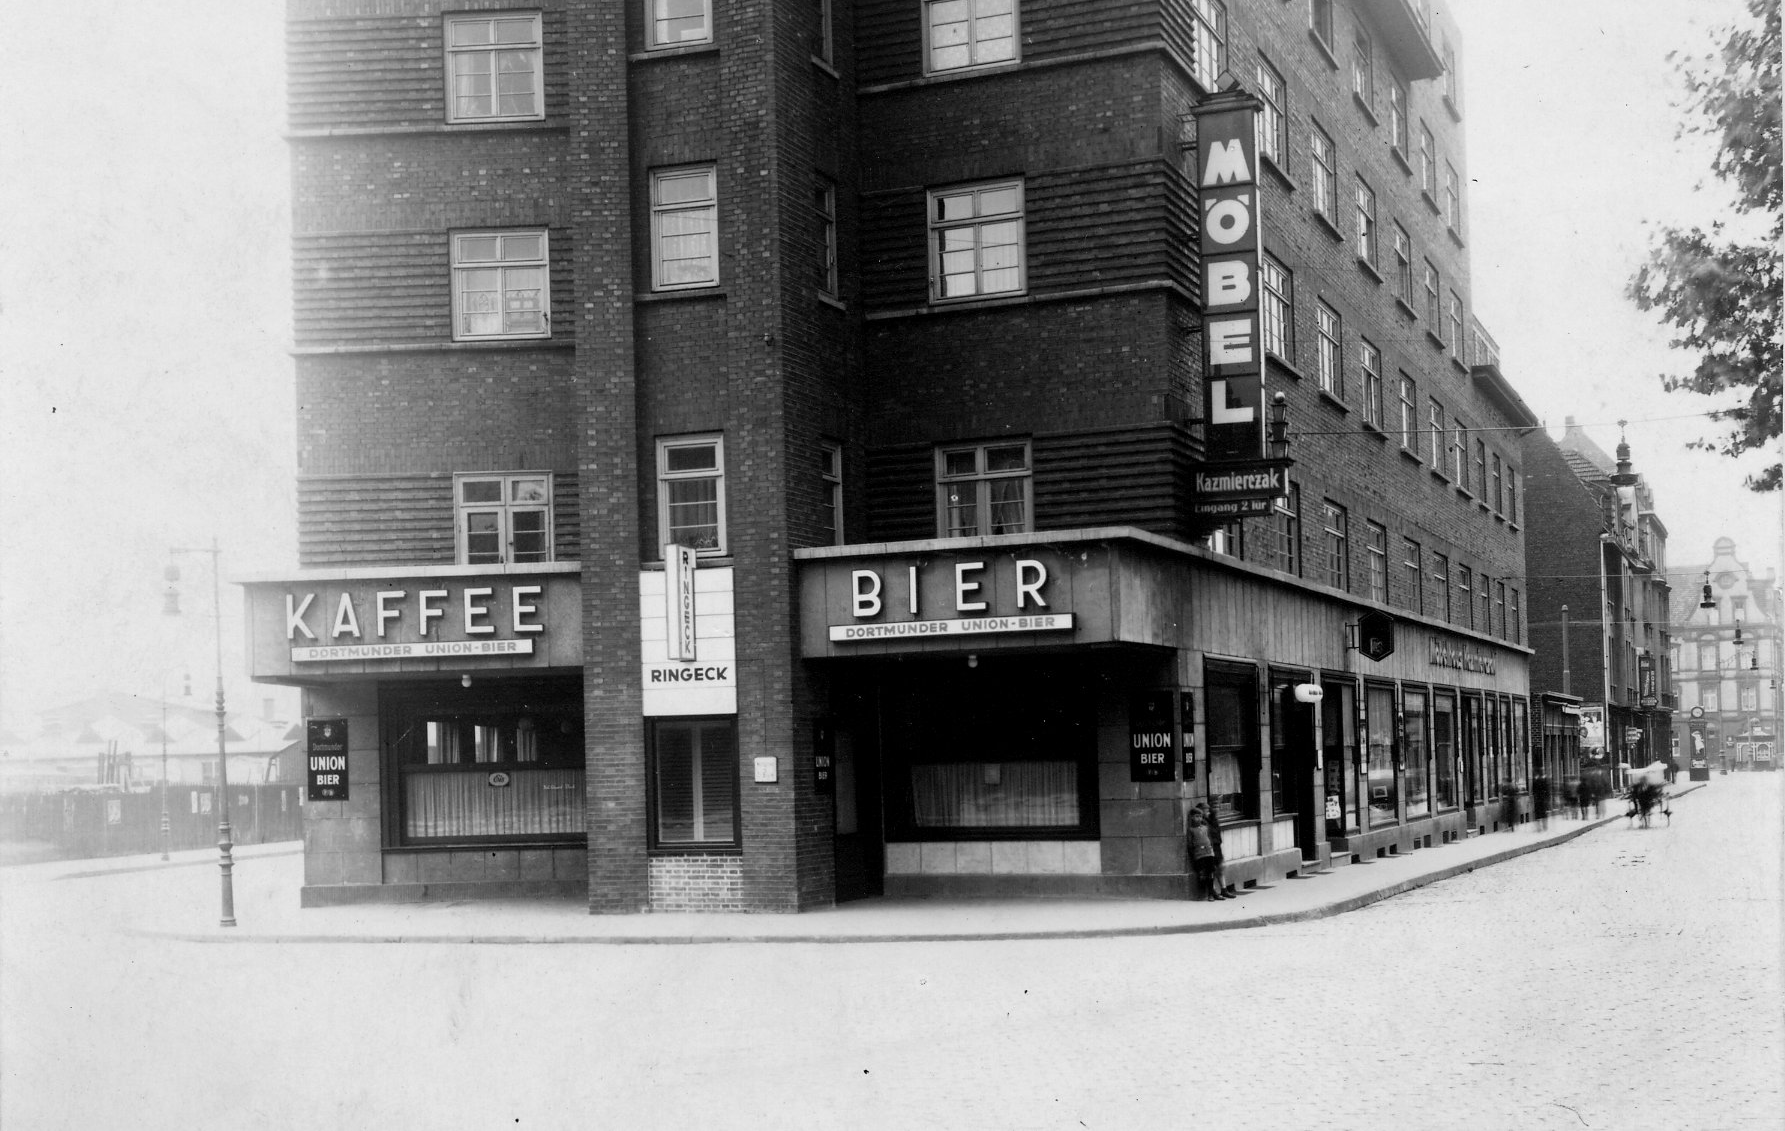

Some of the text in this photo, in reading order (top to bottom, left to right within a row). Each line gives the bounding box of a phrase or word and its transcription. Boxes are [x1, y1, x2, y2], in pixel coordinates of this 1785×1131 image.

[1202, 138, 1254, 425] MÖBEL
[1196, 468, 1279, 491] Kazmierczak
[1241, 500, 1249, 511] 2
[851, 559, 1047, 617] BIER
[286, 585, 544, 639] KAFFEE
[682, 551, 691, 654] RINGECK
[846, 617, 1056, 638] DORTMUNDER UNION-BIER
[309, 641, 518, 660] DORTMUNDER UNION-BIER
[651, 666, 728, 683] RINGECK
[1133, 733, 1170, 748] UNION
[310, 756, 345, 770] UNION
[1141, 753, 1164, 763] BIER
[317, 775, 339, 785] BIER
